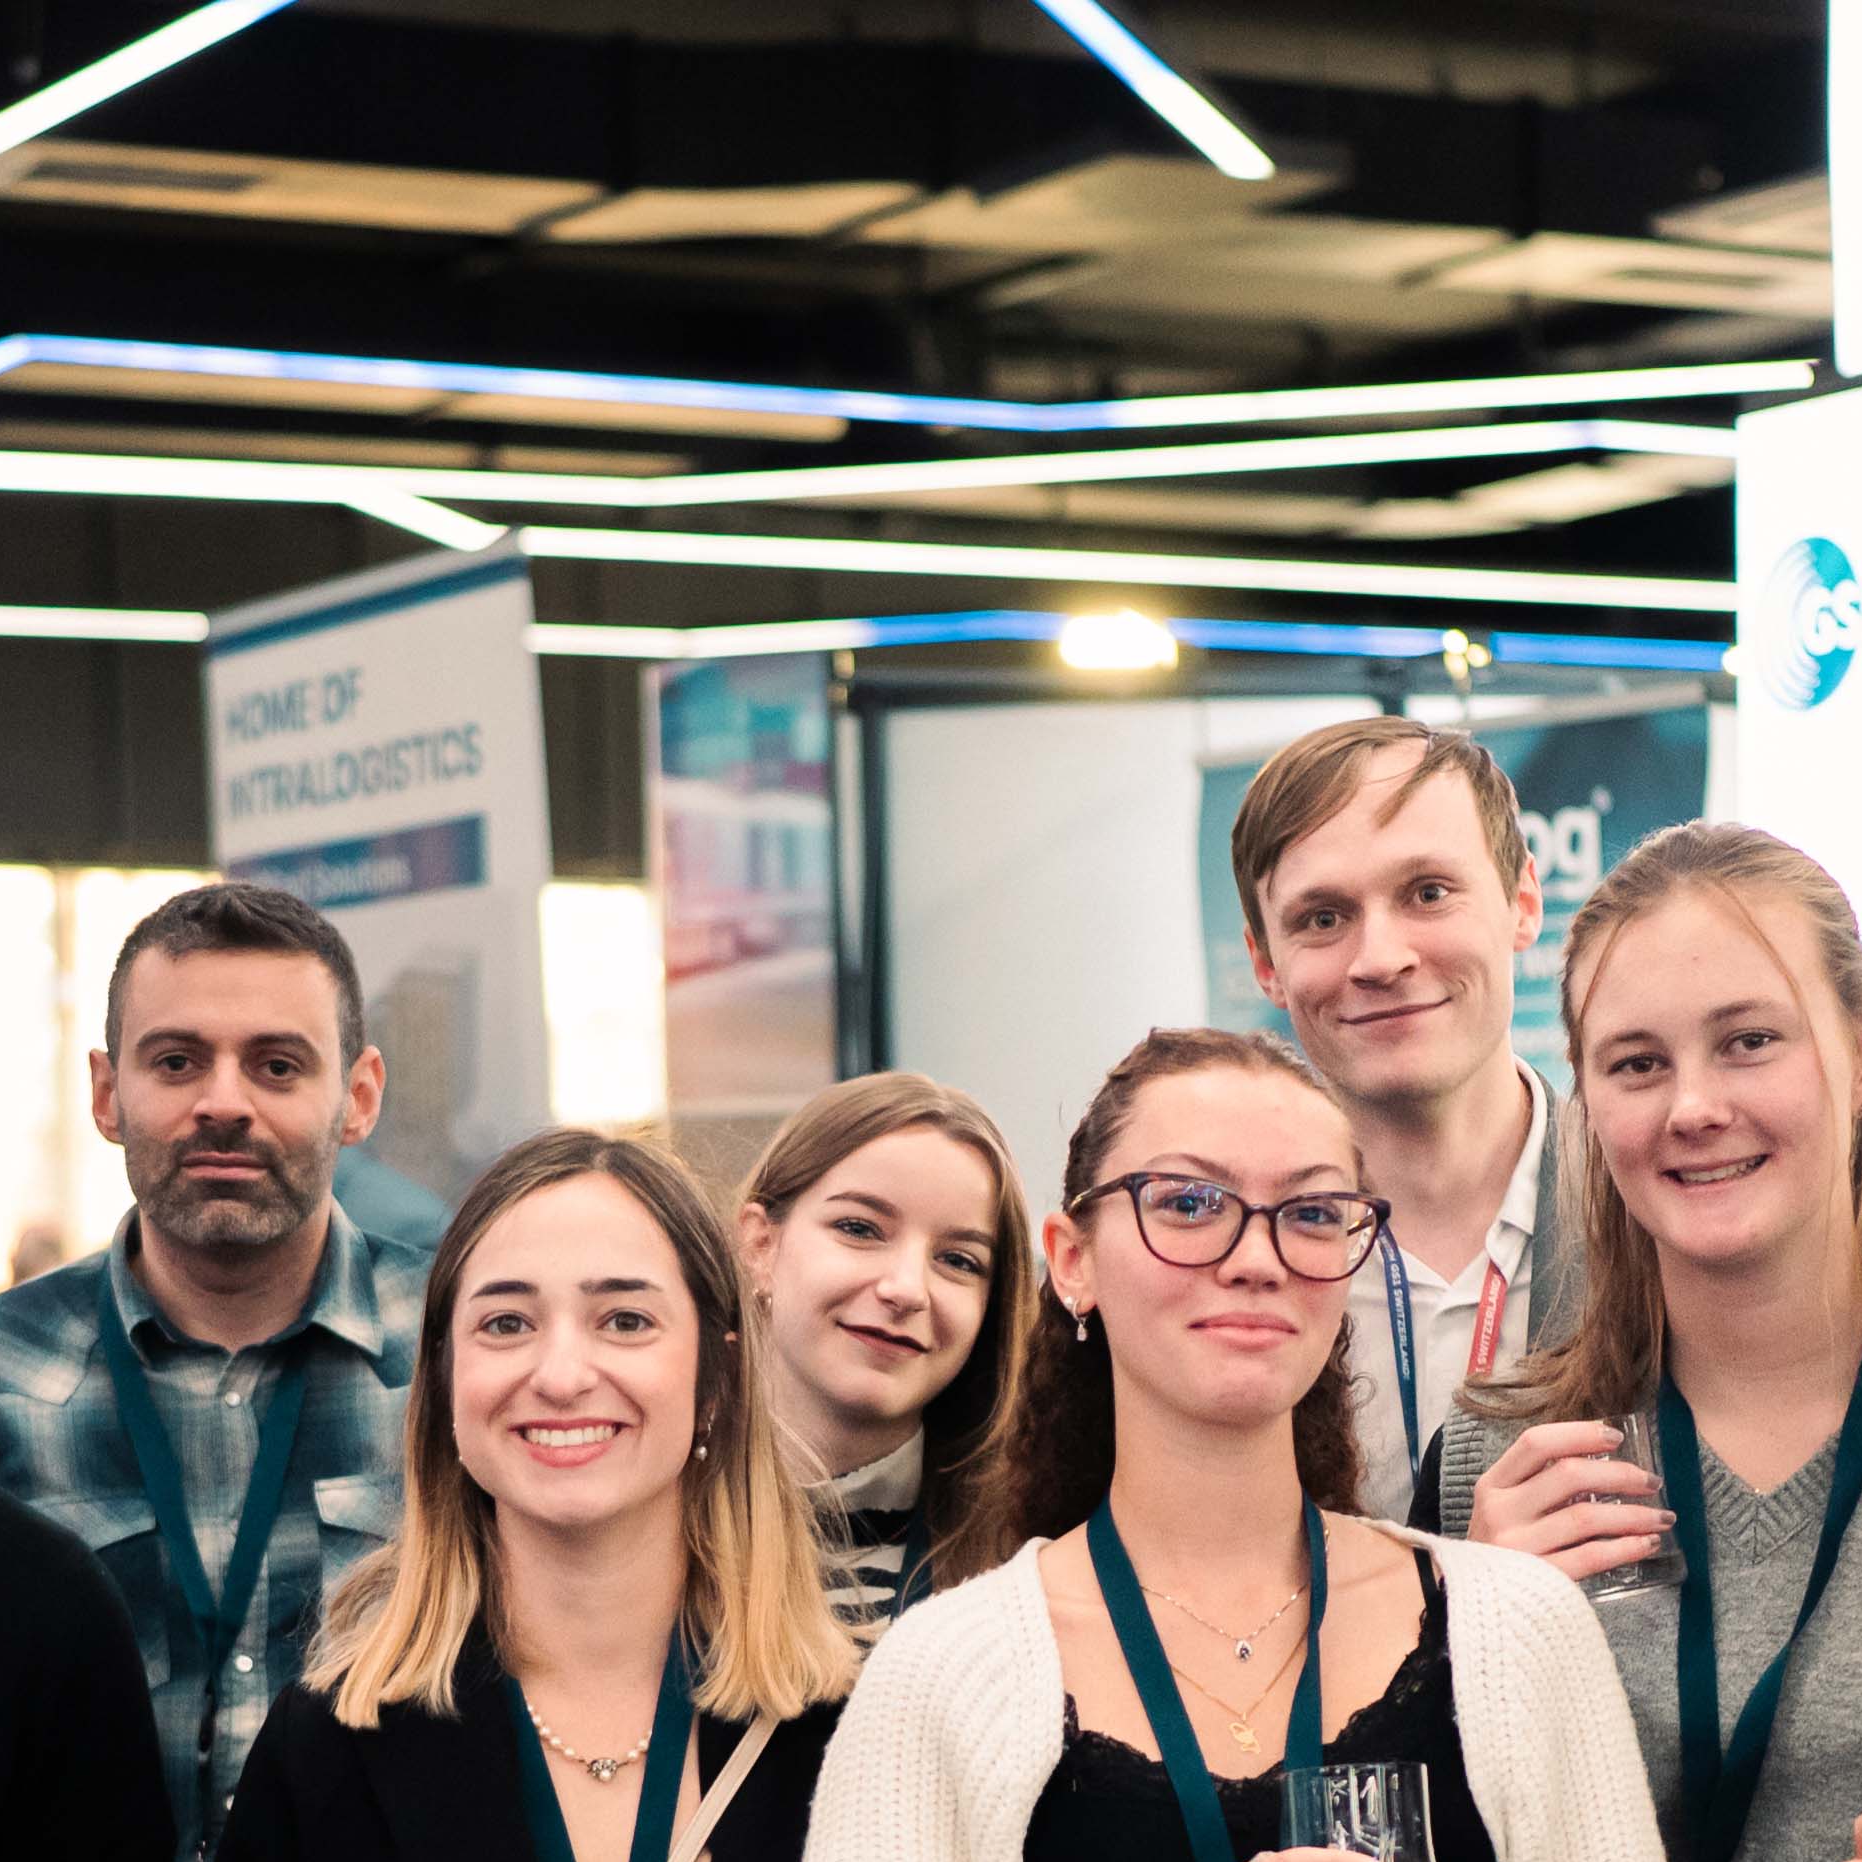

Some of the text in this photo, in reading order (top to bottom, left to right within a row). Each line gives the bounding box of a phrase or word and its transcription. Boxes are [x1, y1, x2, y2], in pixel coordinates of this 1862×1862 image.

[227, 667, 360, 740] HOME OF
[230, 723, 482, 816] INTRALOGISTICS
[1390, 1263, 1402, 1286] GS1
